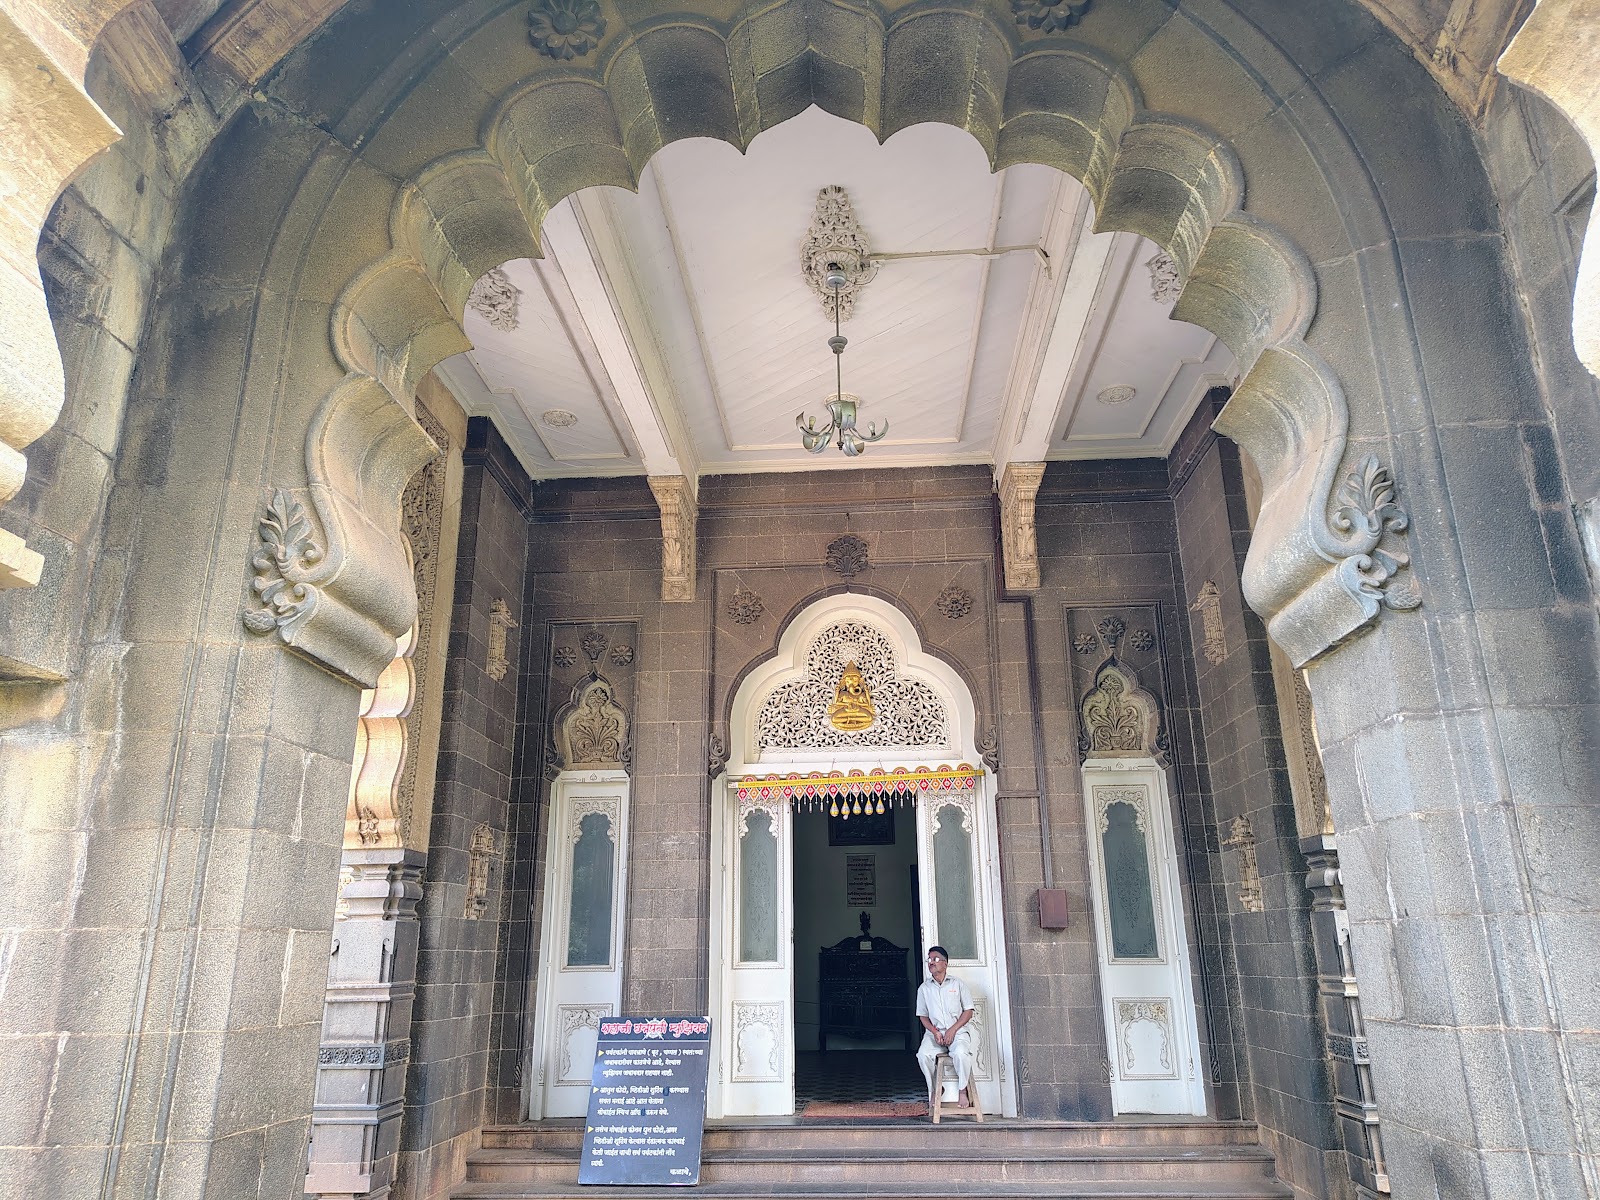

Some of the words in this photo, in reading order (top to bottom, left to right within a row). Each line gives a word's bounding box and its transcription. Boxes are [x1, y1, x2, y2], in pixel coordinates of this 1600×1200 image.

[601, 1020, 632, 1035] शहाजी
[634, 1020, 668, 1034] छत्रपती
[669, 1020, 708, 1038] म्युझियम
